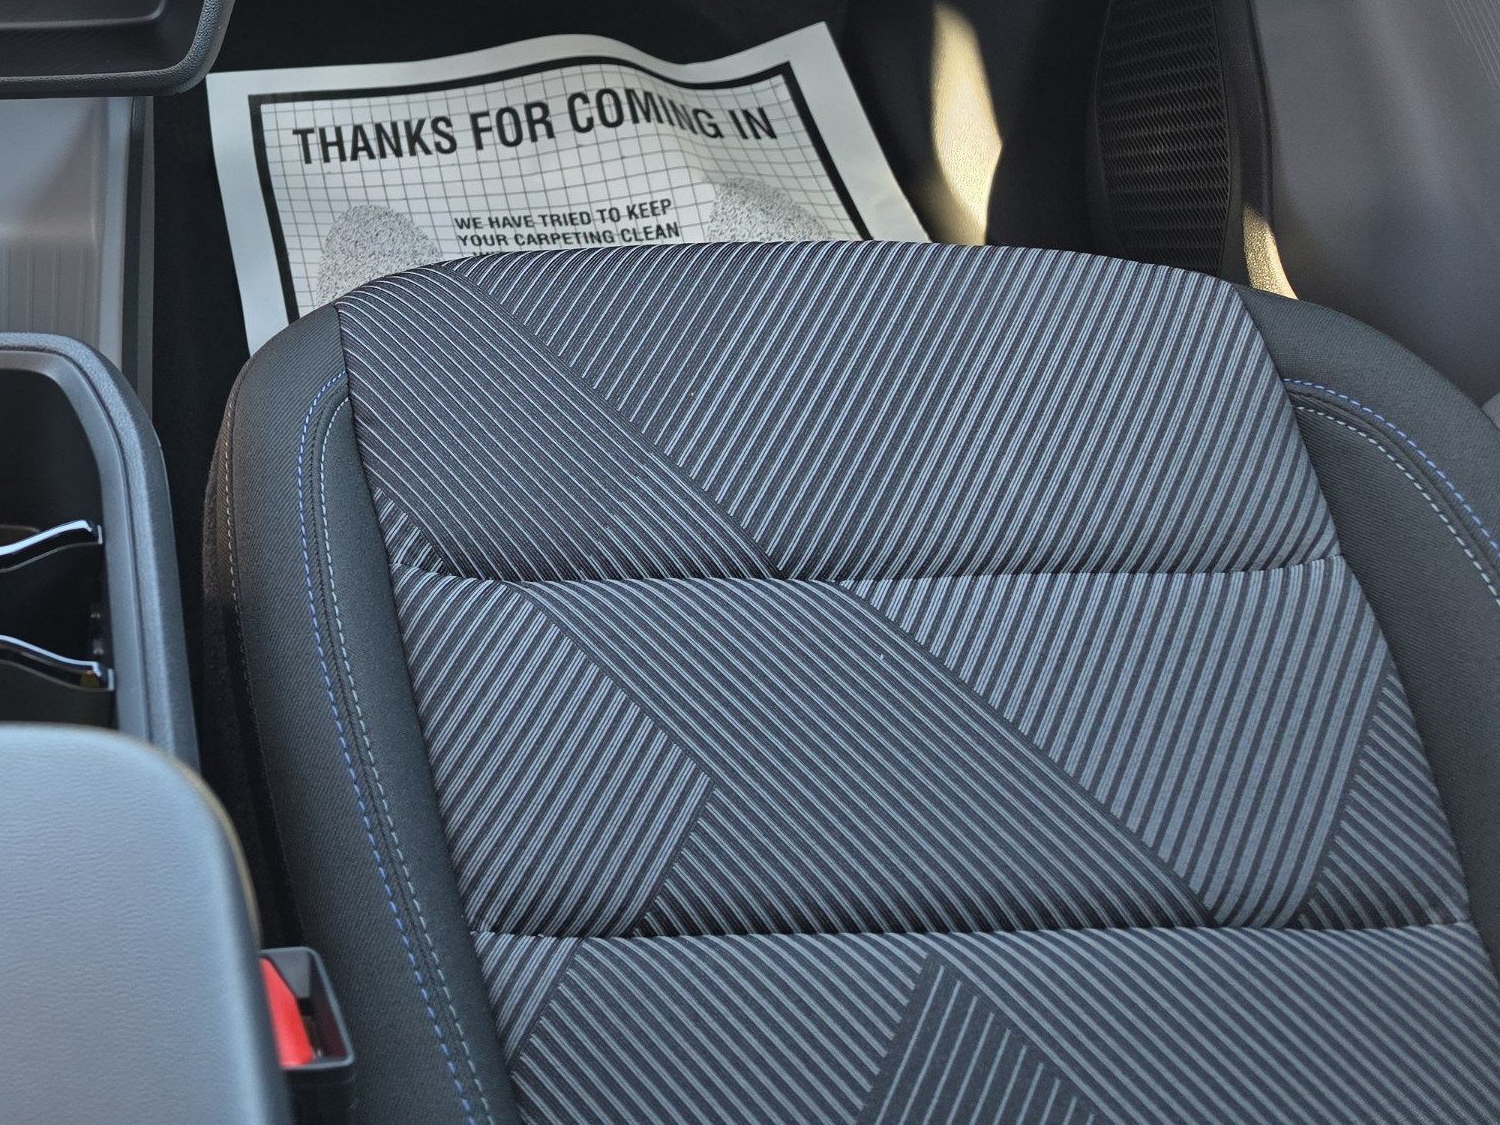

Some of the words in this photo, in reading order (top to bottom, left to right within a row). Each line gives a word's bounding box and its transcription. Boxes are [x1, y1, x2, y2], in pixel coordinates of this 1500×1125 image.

[292, 114, 459, 165] THANKS
[469, 101, 557, 151] FOR
[566, 87, 725, 140] COMING
[730, 106, 779, 140] IN
[454, 216, 483, 231] WE
[488, 214, 535, 230] HAVE
[538, 210, 592, 228] TRIED
[596, 205, 622, 223] TO
[626, 197, 673, 219] KEEP
[455, 233, 509, 248] YOUR
[513, 227, 616, 247] CARPETING
[620, 221, 681, 243] CLEAN
